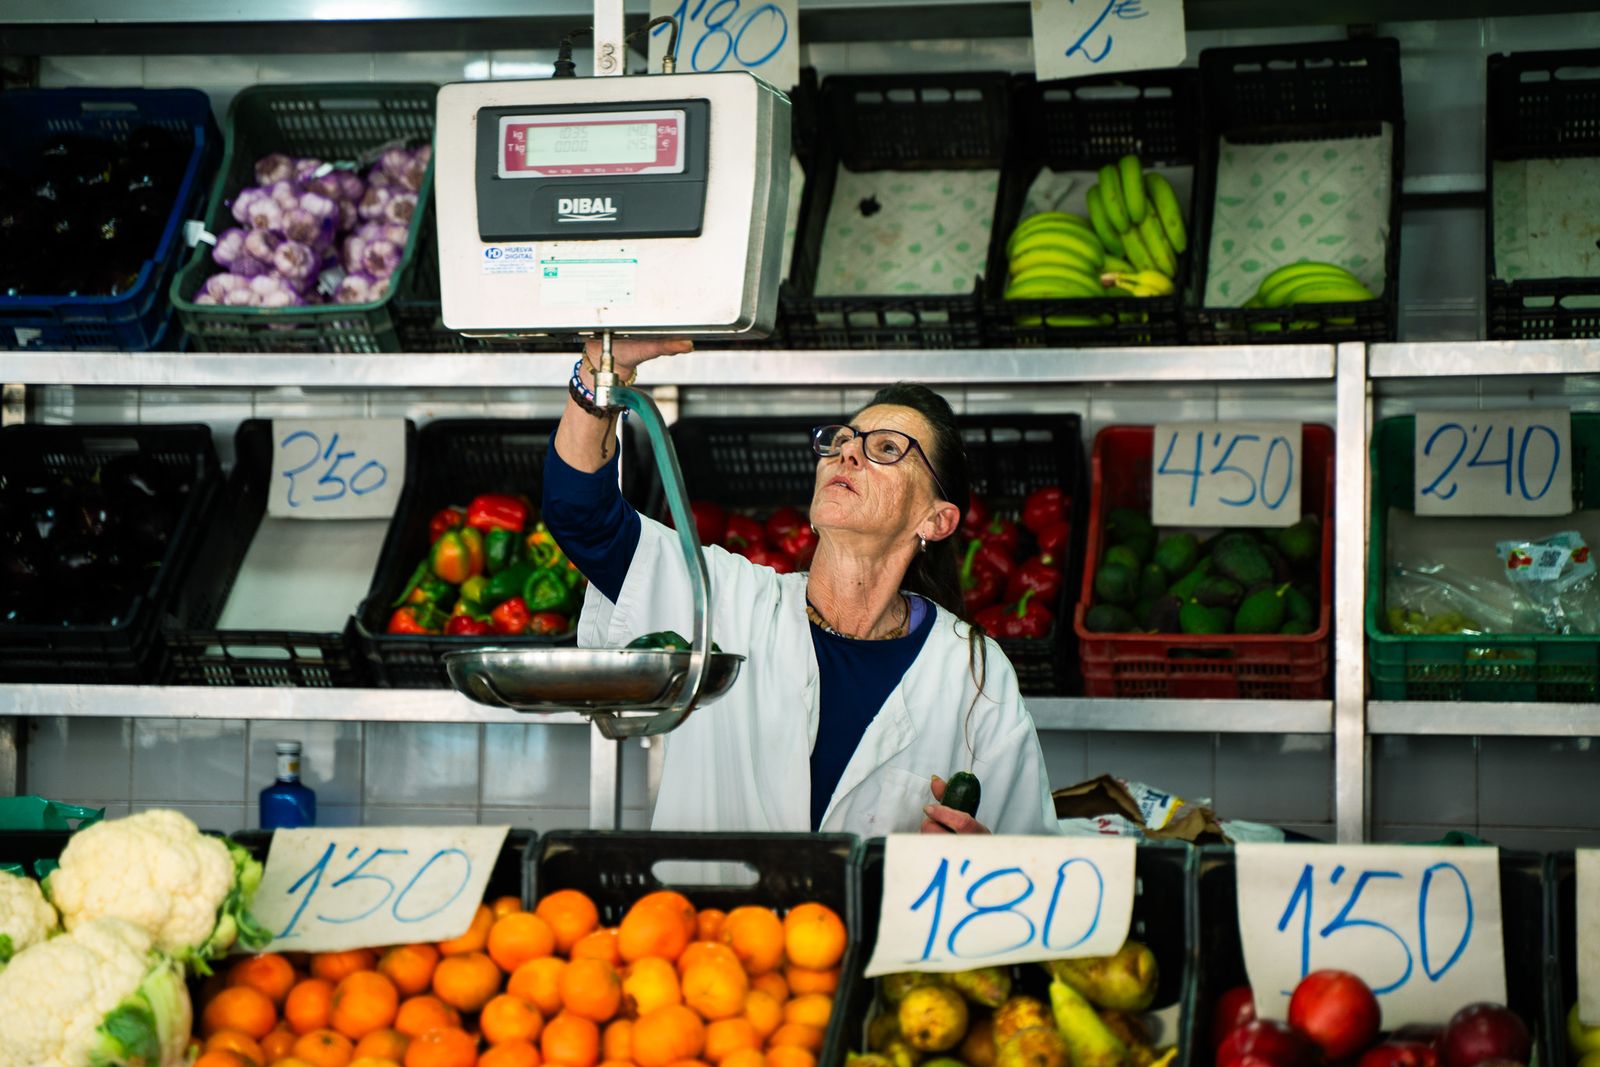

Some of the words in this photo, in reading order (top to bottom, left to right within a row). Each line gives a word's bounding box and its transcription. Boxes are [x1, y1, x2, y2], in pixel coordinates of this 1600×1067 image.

[558, 197, 617, 214] DIBAL
[1157, 431, 1294, 510] 4'50
[1421, 422, 1561, 501] 2'40
[275, 841, 471, 939] 1'50
[904, 857, 1104, 962] 1'80
[1277, 862, 1474, 996] 1'50
